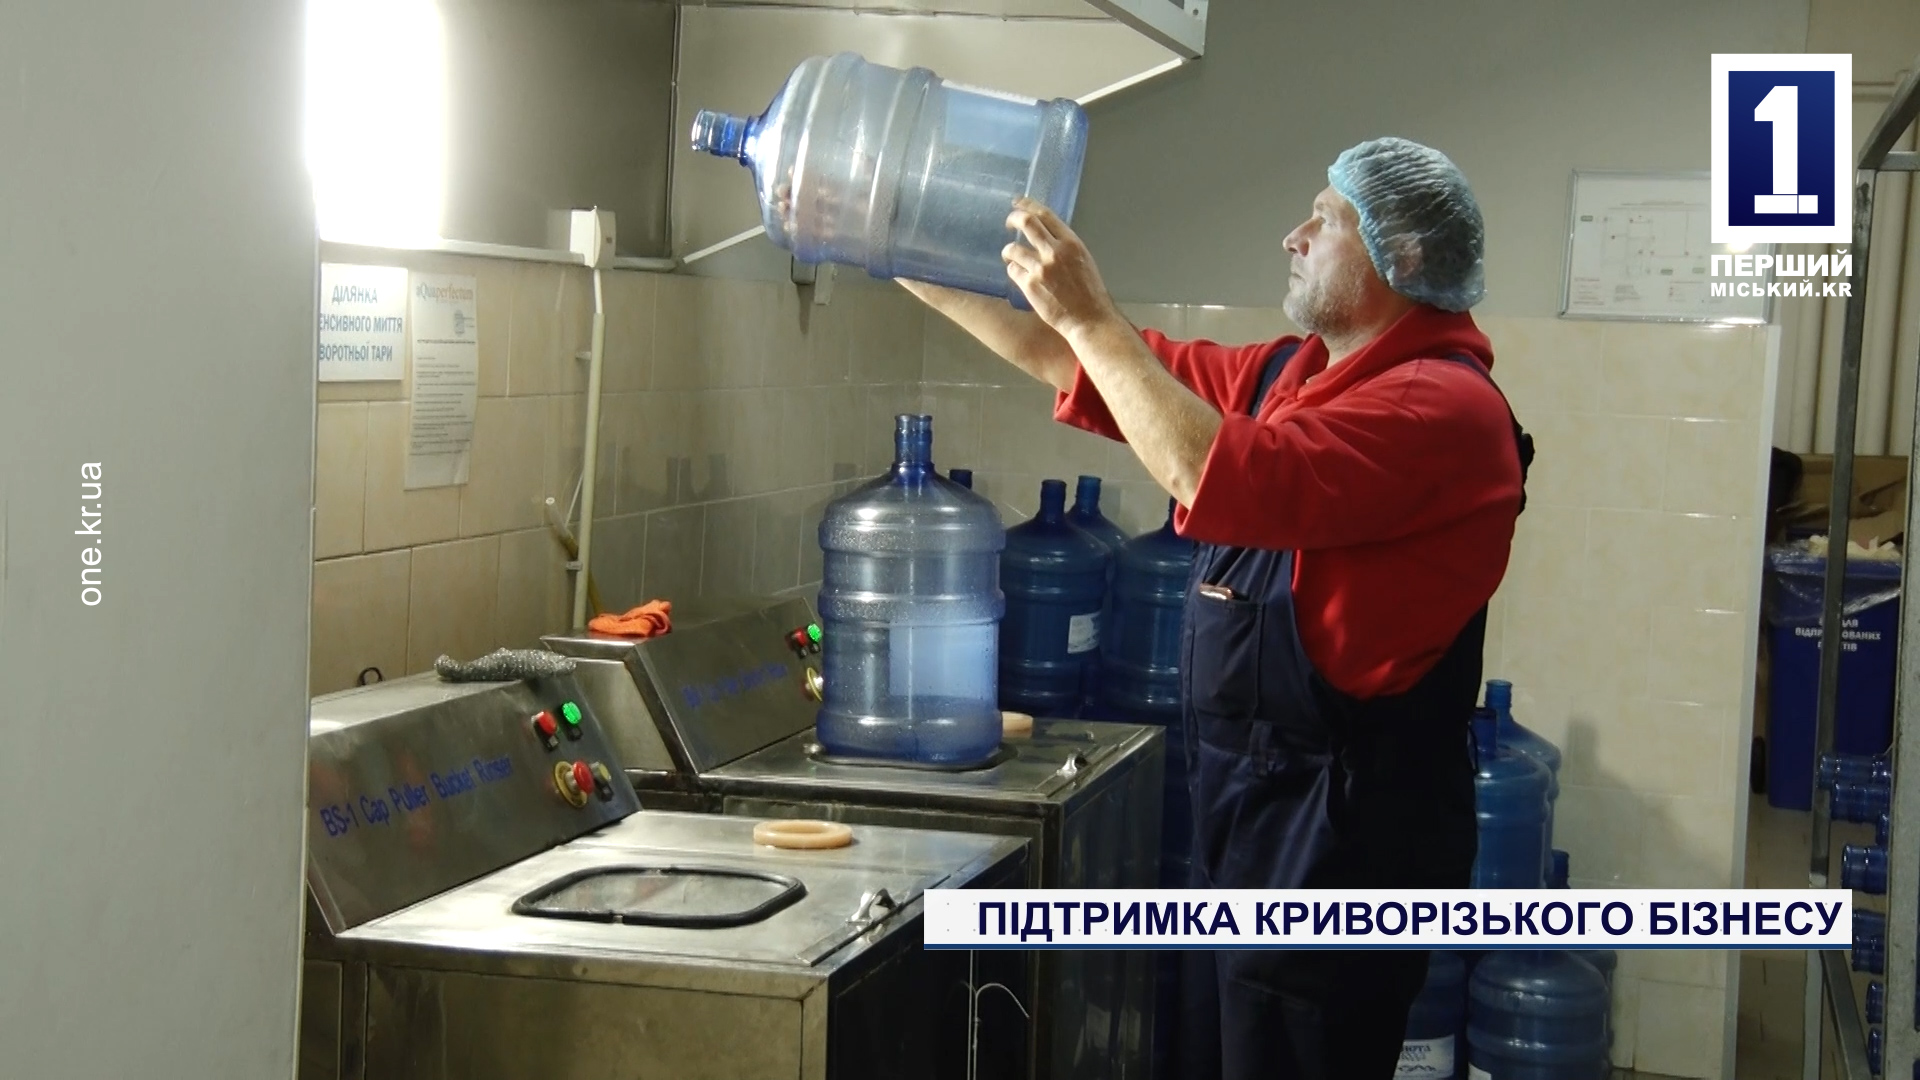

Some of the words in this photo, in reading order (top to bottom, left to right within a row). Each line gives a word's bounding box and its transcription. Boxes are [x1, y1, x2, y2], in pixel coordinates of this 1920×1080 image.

[332, 285, 377, 304] ДІЛЯНКА
[373, 317, 403, 333] МИТТЯ
[371, 345, 392, 361] ТАРИ
[320, 804, 359, 836] BS-1
[360, 795, 389, 826] Cap
[388, 783, 430, 811] Puller
[430, 768, 476, 798] Bucket
[473, 756, 512, 782] Rinser
